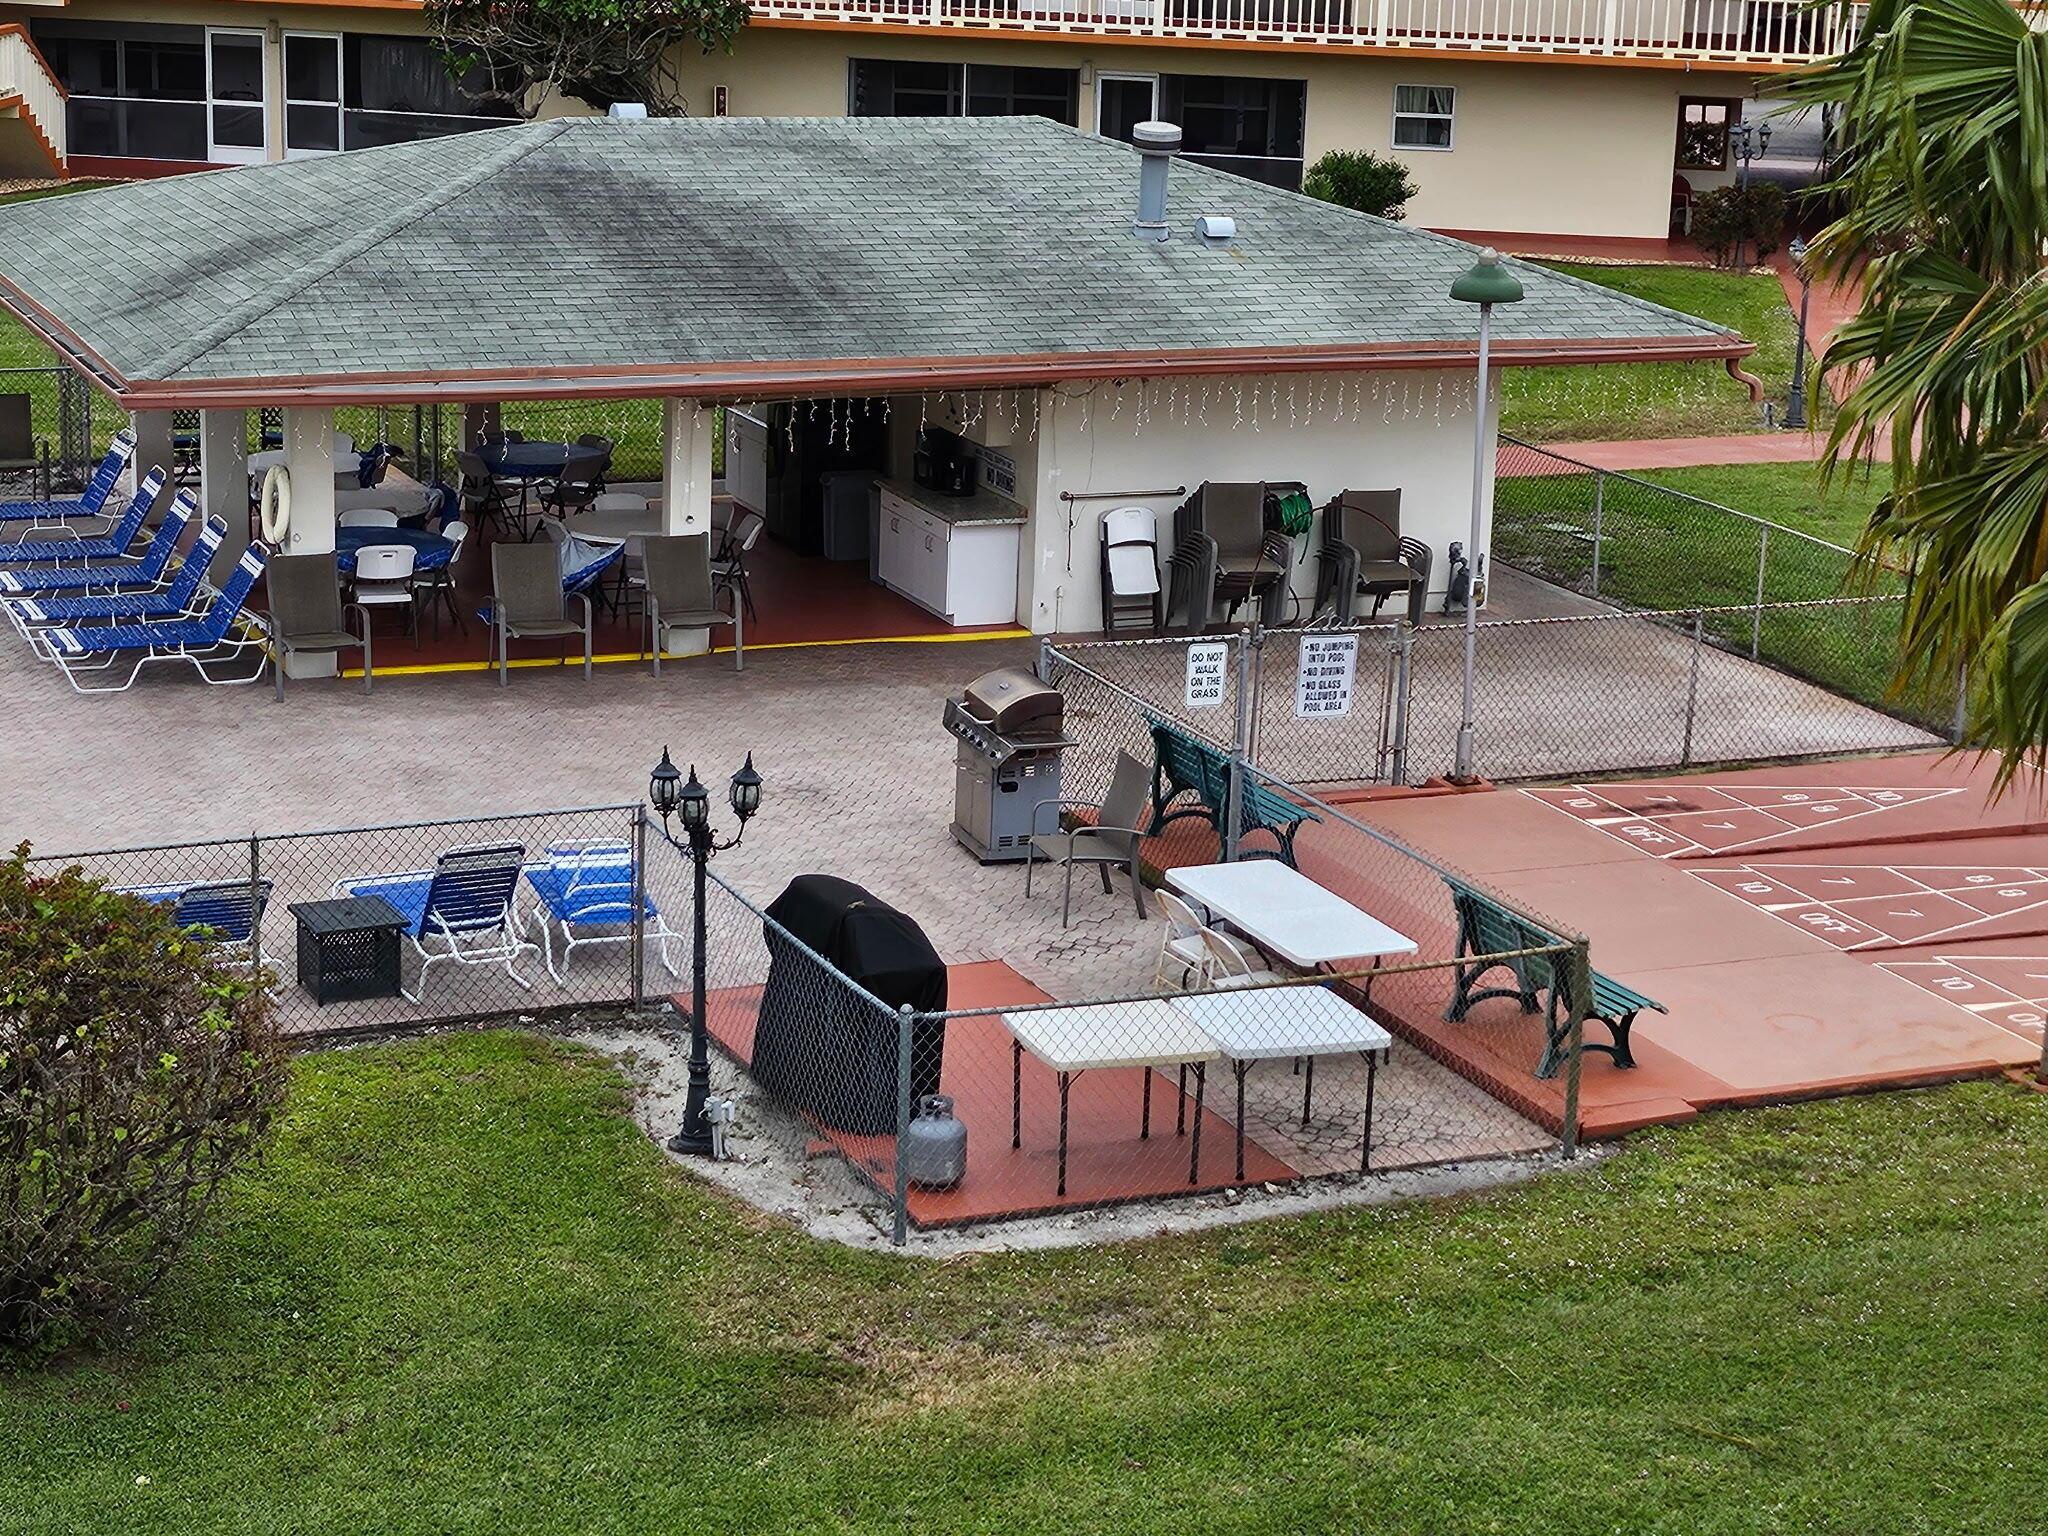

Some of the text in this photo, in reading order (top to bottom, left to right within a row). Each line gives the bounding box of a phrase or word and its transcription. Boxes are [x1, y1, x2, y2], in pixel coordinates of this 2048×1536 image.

[1309, 641, 1354, 651] NO JUMPING
[1191, 652, 1223, 662] DO NOT
[1308, 652, 1345, 662] INTO POOL
[1195, 664, 1218, 674] WALK
[1307, 666, 1345, 676] NO DIVING
[1190, 676, 1221, 687] ON THE
[1306, 679, 1341, 690] NO GLASS
[1191, 688, 1219, 699] GRASS
[1305, 690, 1347, 701] ALLOWED IN
[1303, 702, 1342, 711] POOL AREA
[1621, 825, 1676, 843] OFF
[1799, 912, 1861, 933] OFF
[1931, 976, 1976, 990] 10
